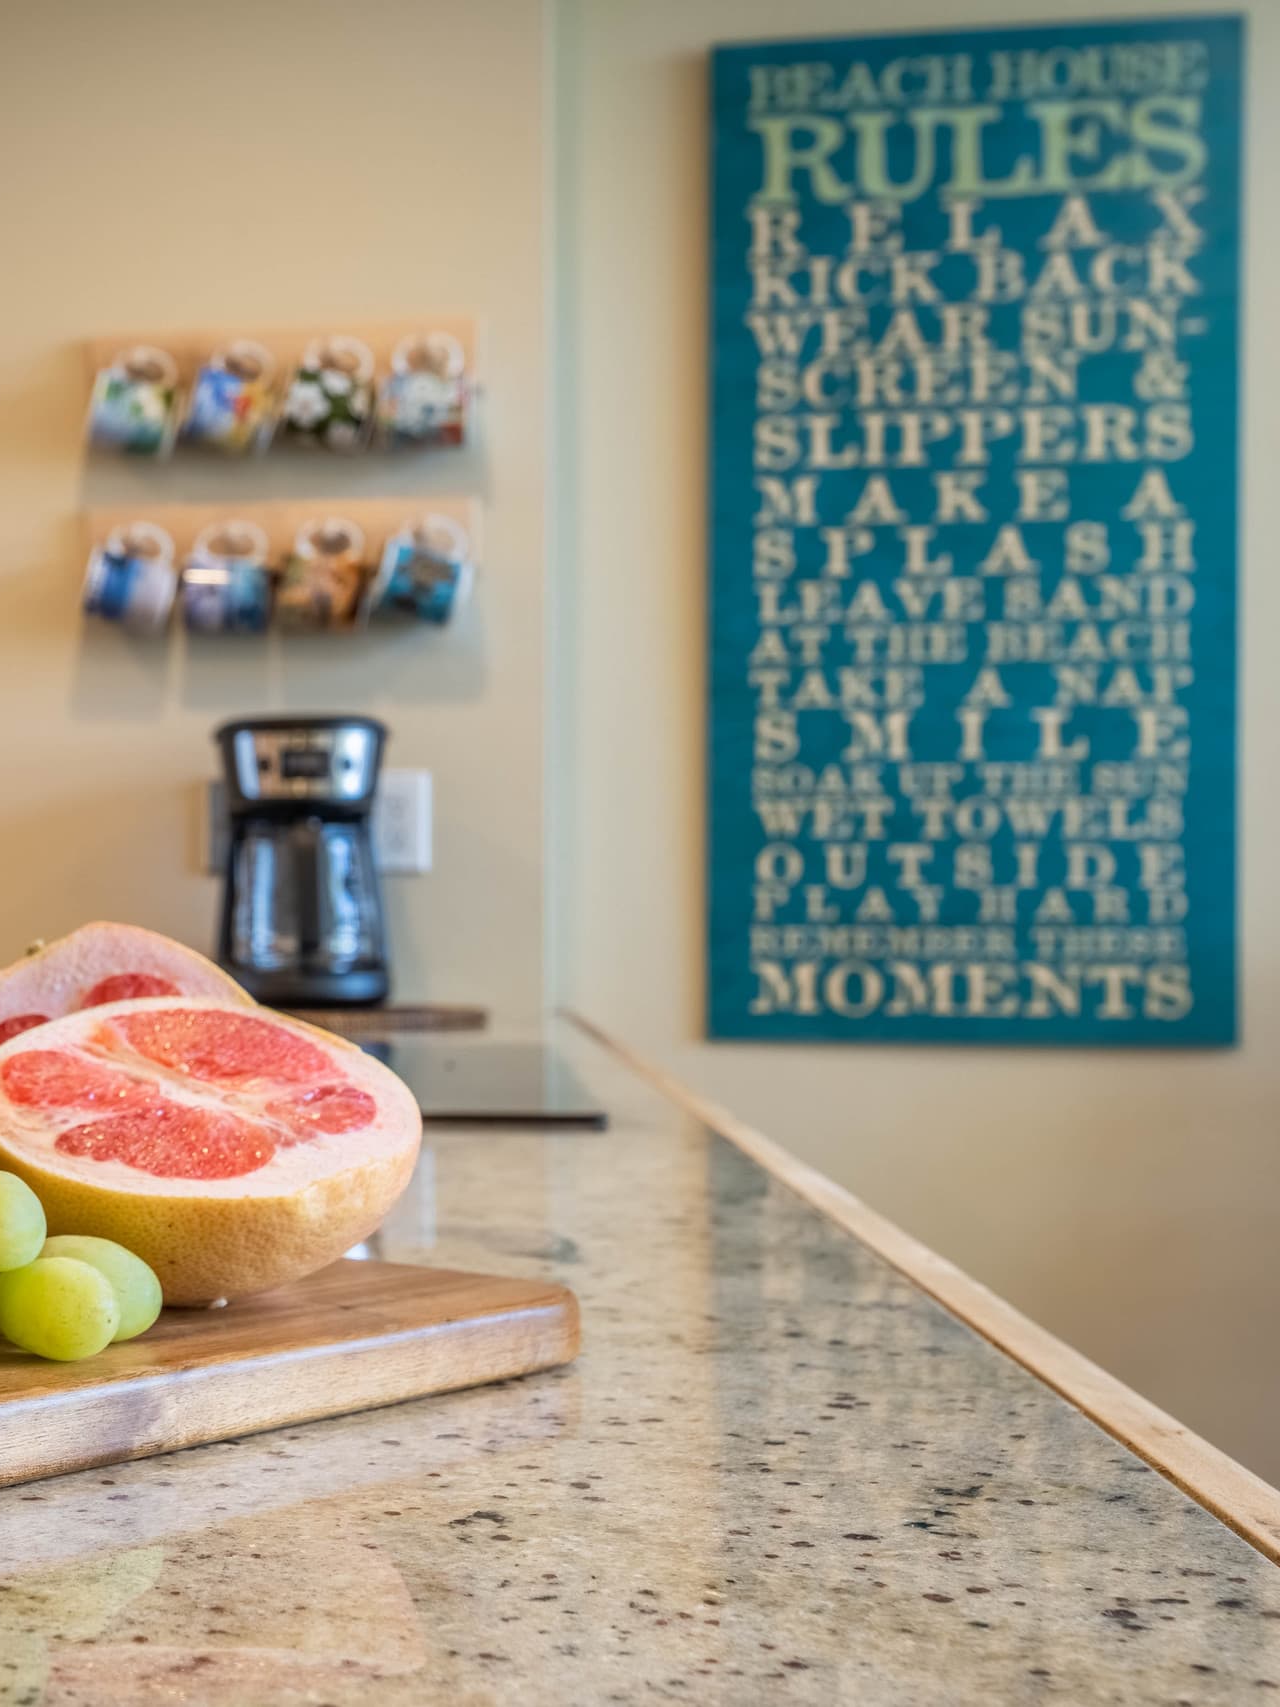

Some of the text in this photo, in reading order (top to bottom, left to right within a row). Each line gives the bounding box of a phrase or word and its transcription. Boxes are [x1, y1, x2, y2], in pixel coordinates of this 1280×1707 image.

[748, 40, 1209, 114] BEACH HOUSE
[748, 96, 1209, 205] RULES
[747, 186, 1208, 258] RELAX
[750, 242, 1201, 310] KICK BACK
[746, 303, 992, 357] WEAR
[755, 349, 1189, 411] SCREEN &
[754, 403, 1195, 471] SLIPPERS
[755, 466, 1184, 527] MAKE A
[753, 521, 1198, 580] SPLASH
[754, 571, 1196, 627] LEAVE SAND
[748, 619, 1192, 667] AT THE BEACH
[748, 663, 1196, 712] TAKE A NAP
[754, 704, 1191, 764] SMILE
[751, 761, 1190, 799] SOAK UP THE SUN
[755, 796, 1186, 841] WET TOWELS
[754, 842, 1187, 890] OUTSIDE
[752, 886, 1190, 924] PLAY HARD
[750, 925, 1190, 962] REMEMBER THESE
[748, 958, 1196, 1021] MOMENTS
